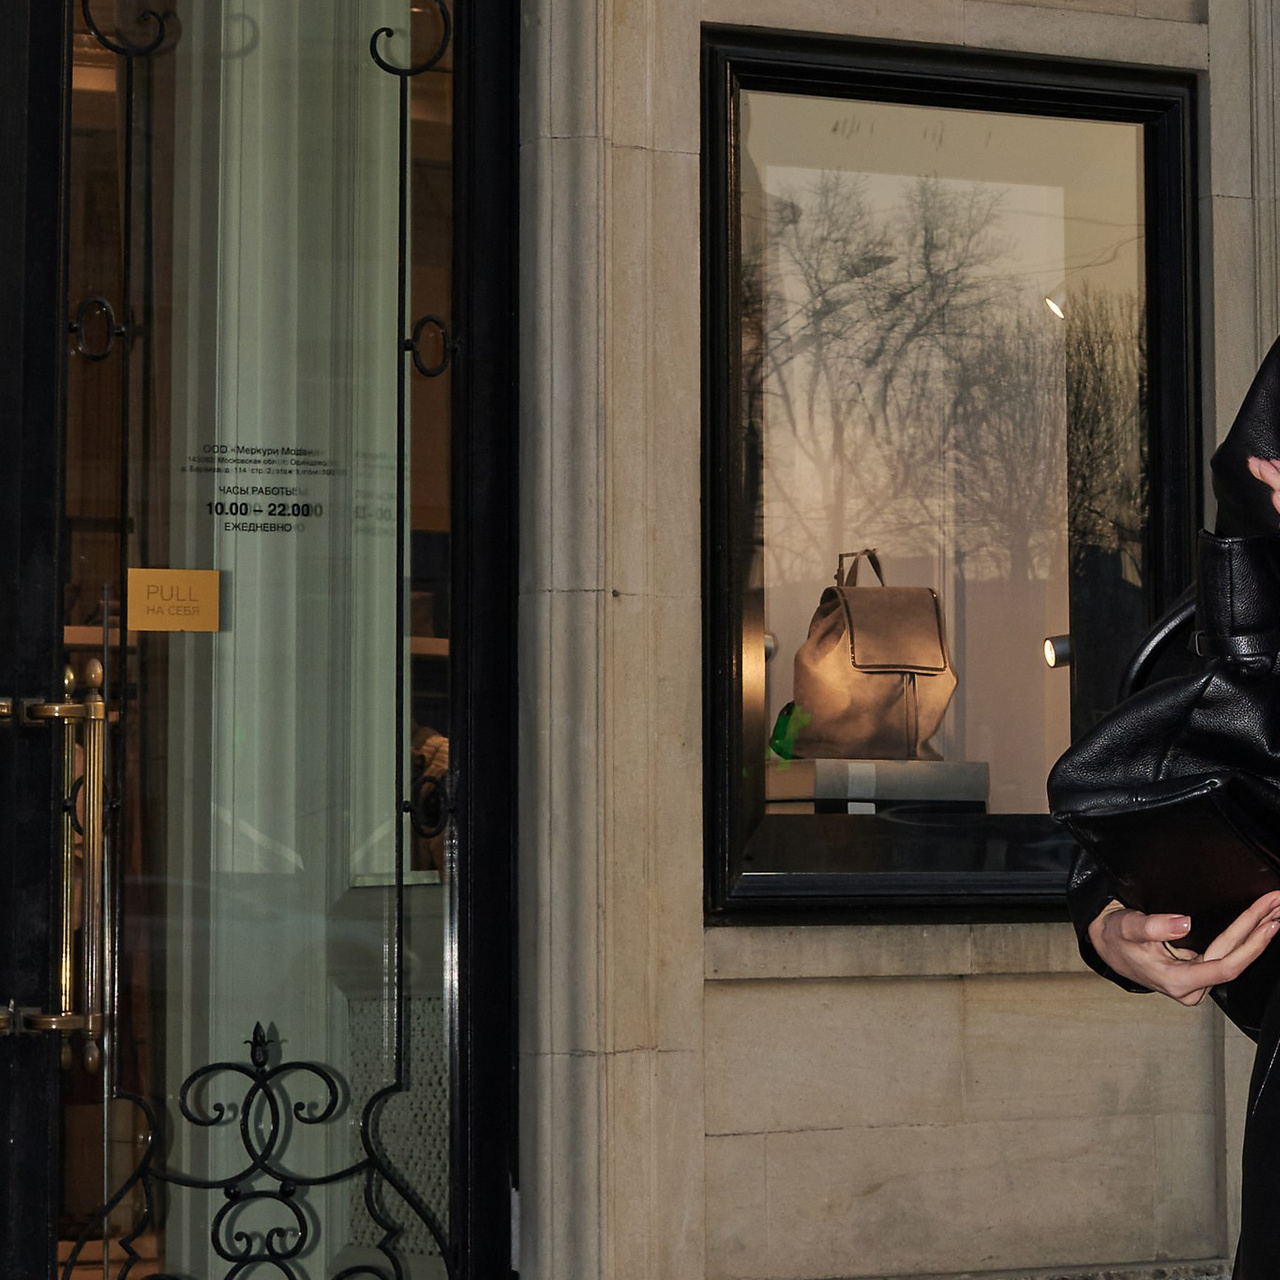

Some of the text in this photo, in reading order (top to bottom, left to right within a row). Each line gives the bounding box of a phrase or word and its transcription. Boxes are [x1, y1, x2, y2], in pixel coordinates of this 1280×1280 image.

[203, 444, 228, 454] ООО
[219, 486, 249, 495] ЧАСЫ
[207, 502, 248, 516] 10.00
[268, 503, 310, 517] 22.00
[224, 522, 292, 532] ЕЖЕДНЕВНО
[146, 584, 199, 602] PULL
[146, 605, 200, 616] НА СЕБЯ
